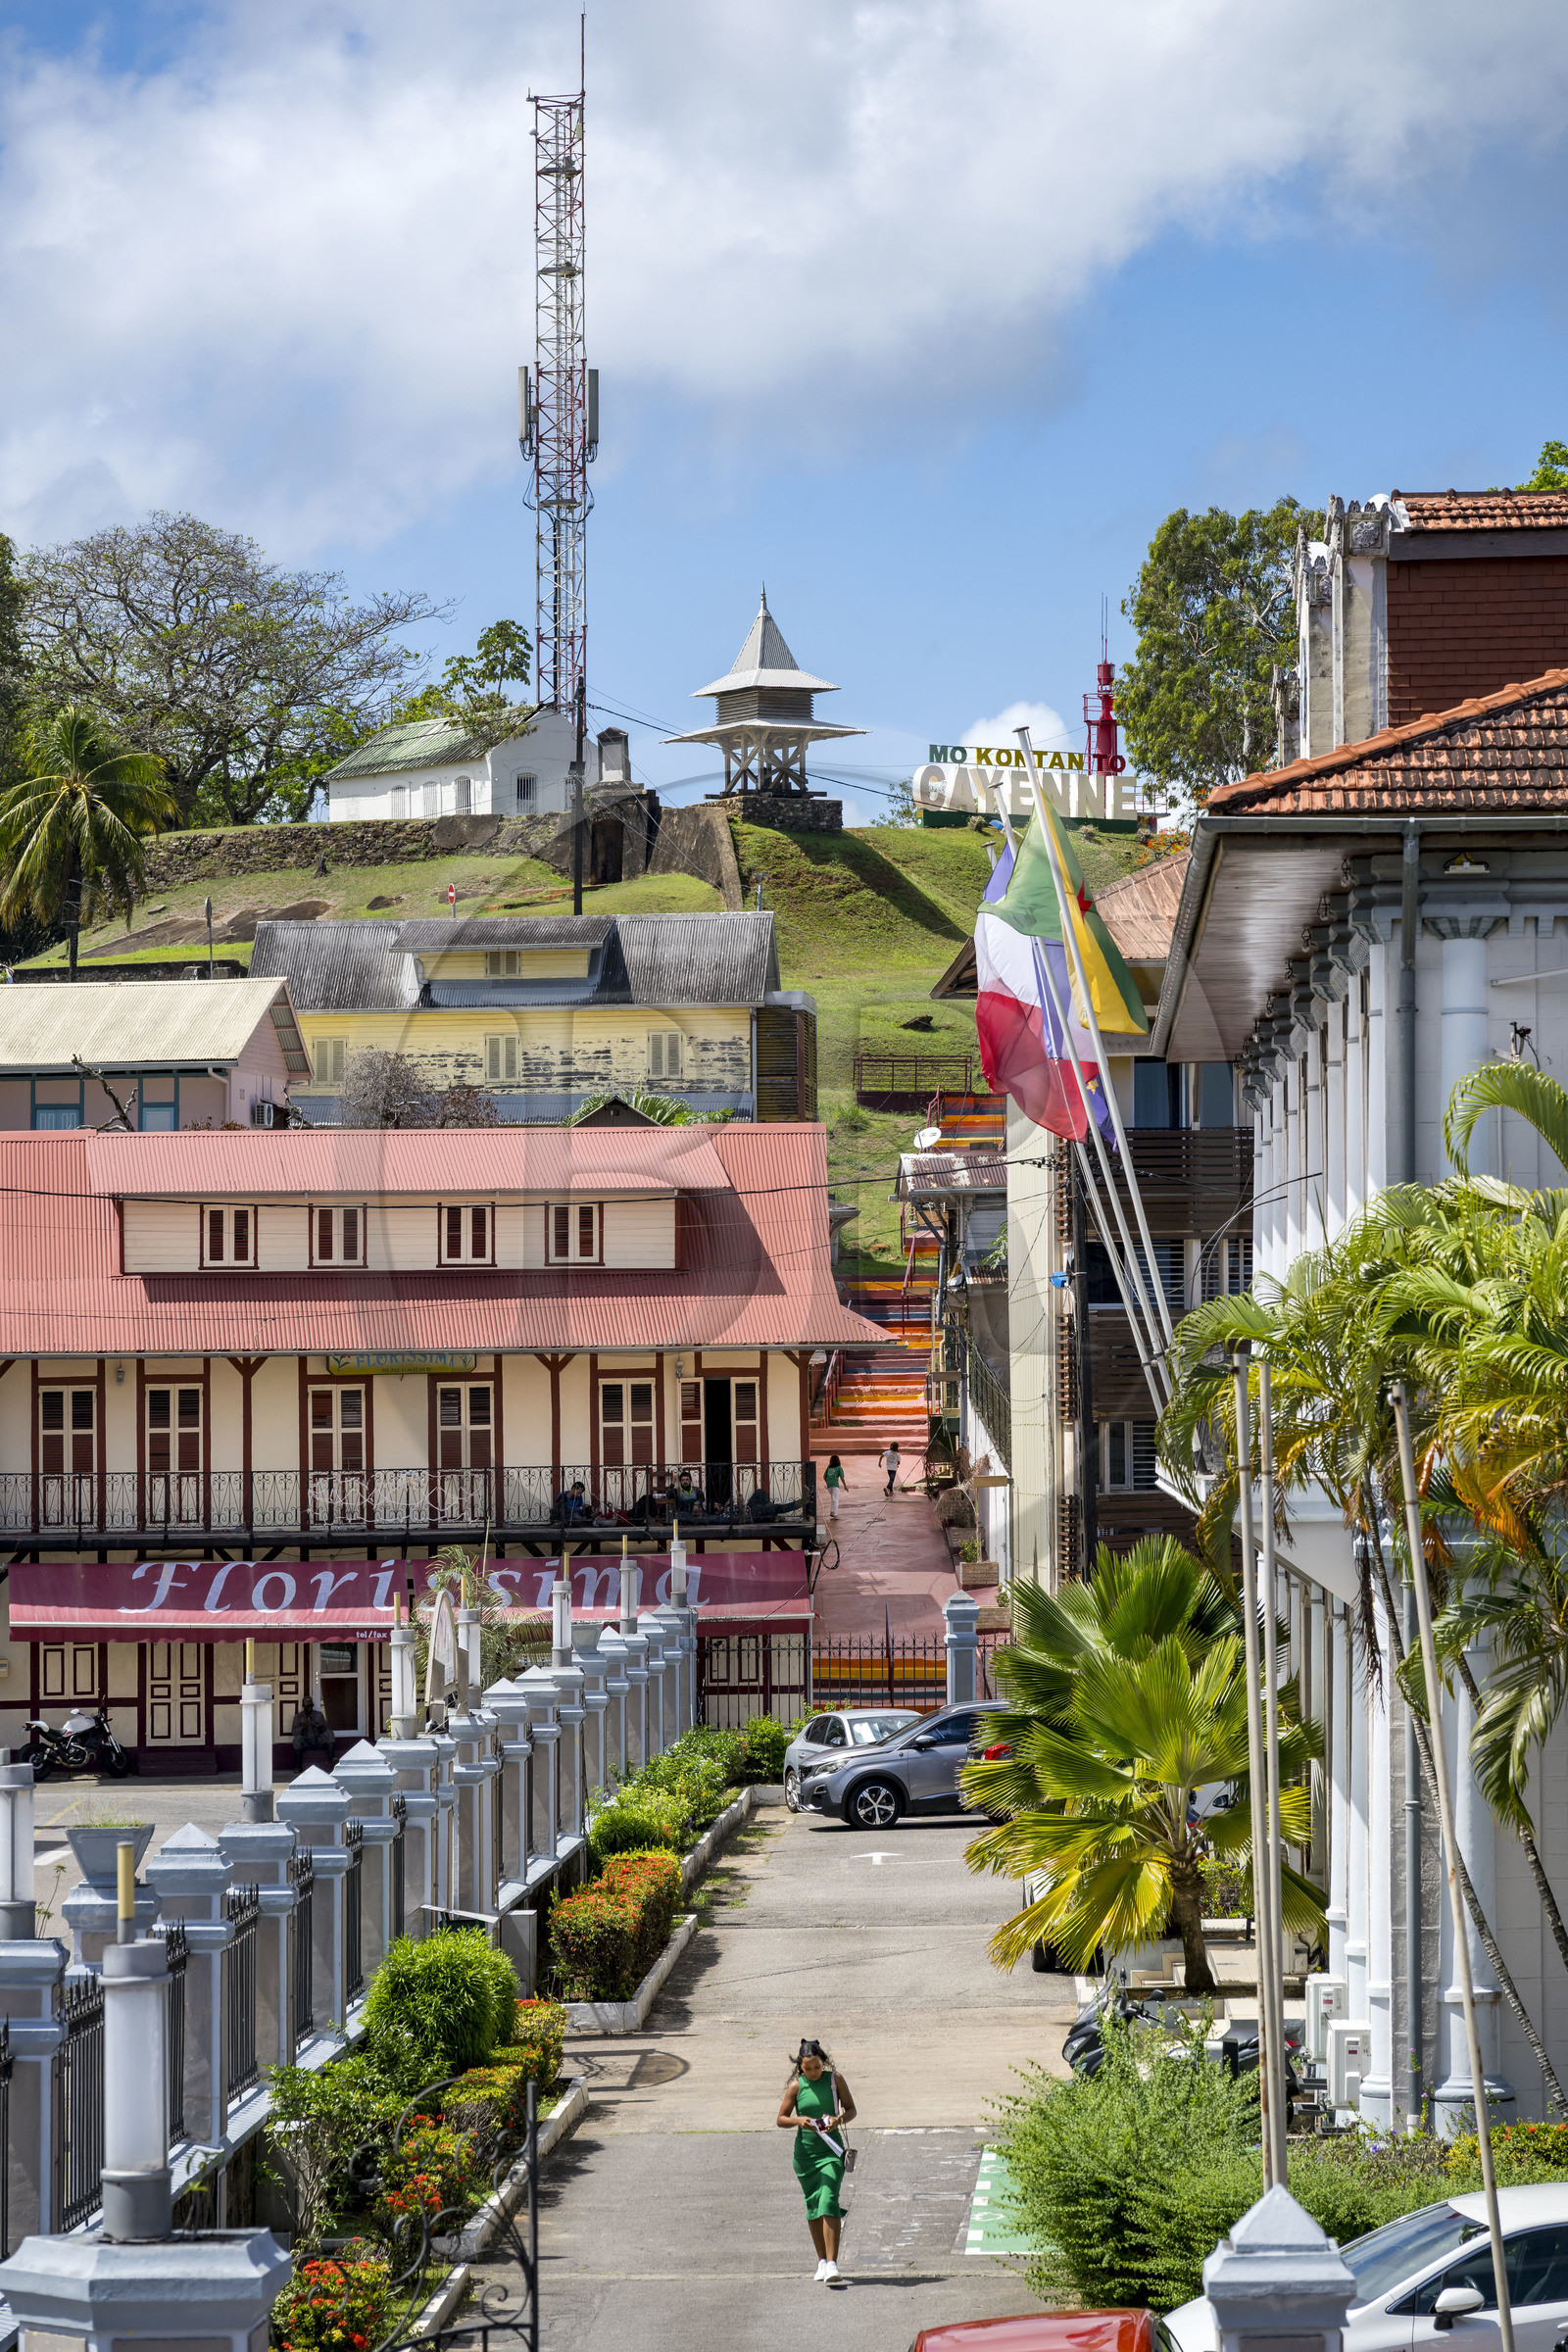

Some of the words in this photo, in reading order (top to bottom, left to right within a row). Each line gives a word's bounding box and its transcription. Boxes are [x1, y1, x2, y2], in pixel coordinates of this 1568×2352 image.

[929, 744, 968, 764] MO
[976, 747, 1084, 771] KONTAN
[1092, 753, 1127, 773] TO
[911, 763, 1138, 821] CAYENNE
[355, 1630, 388, 1639] tel/fax
